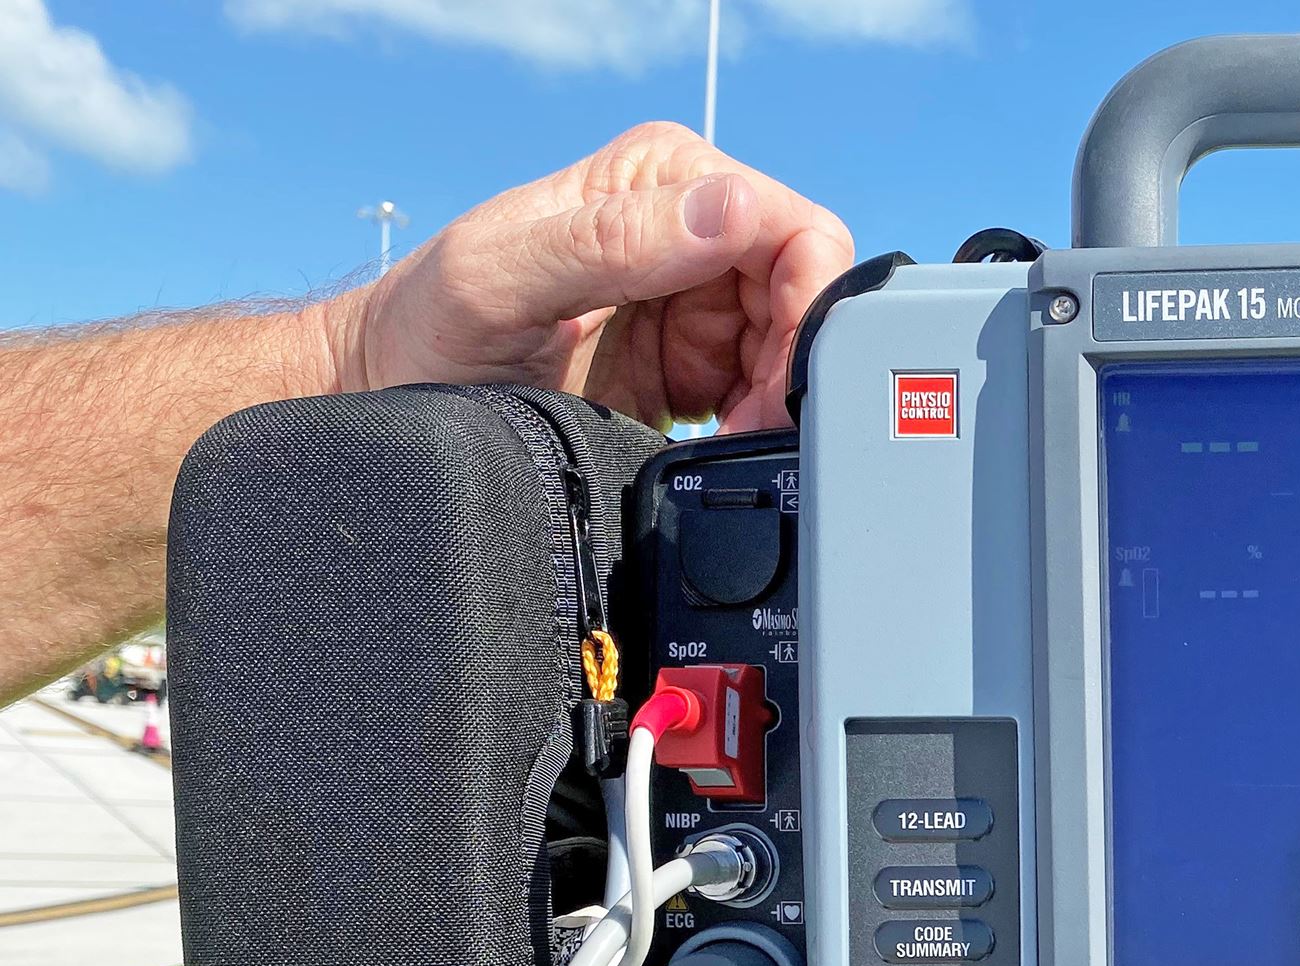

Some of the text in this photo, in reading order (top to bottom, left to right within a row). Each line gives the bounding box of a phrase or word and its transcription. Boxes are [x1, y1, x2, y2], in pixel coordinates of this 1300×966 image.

[1122, 289, 1230, 323] LIFEPAK
[1237, 287, 1267, 320] 15
[901, 391, 951, 408] PHYSIO
[901, 407, 951, 419] CONTROL
[673, 475, 703, 491] CO2
[668, 642, 708, 658] SpO2
[665, 812, 701, 829] NIBP
[898, 812, 967, 830] 12-LEAD
[890, 878, 977, 897] TRANSMIT
[665, 913, 695, 929] ECG
[913, 926, 954, 942] CODE
[896, 943, 971, 959] SUMMARY
